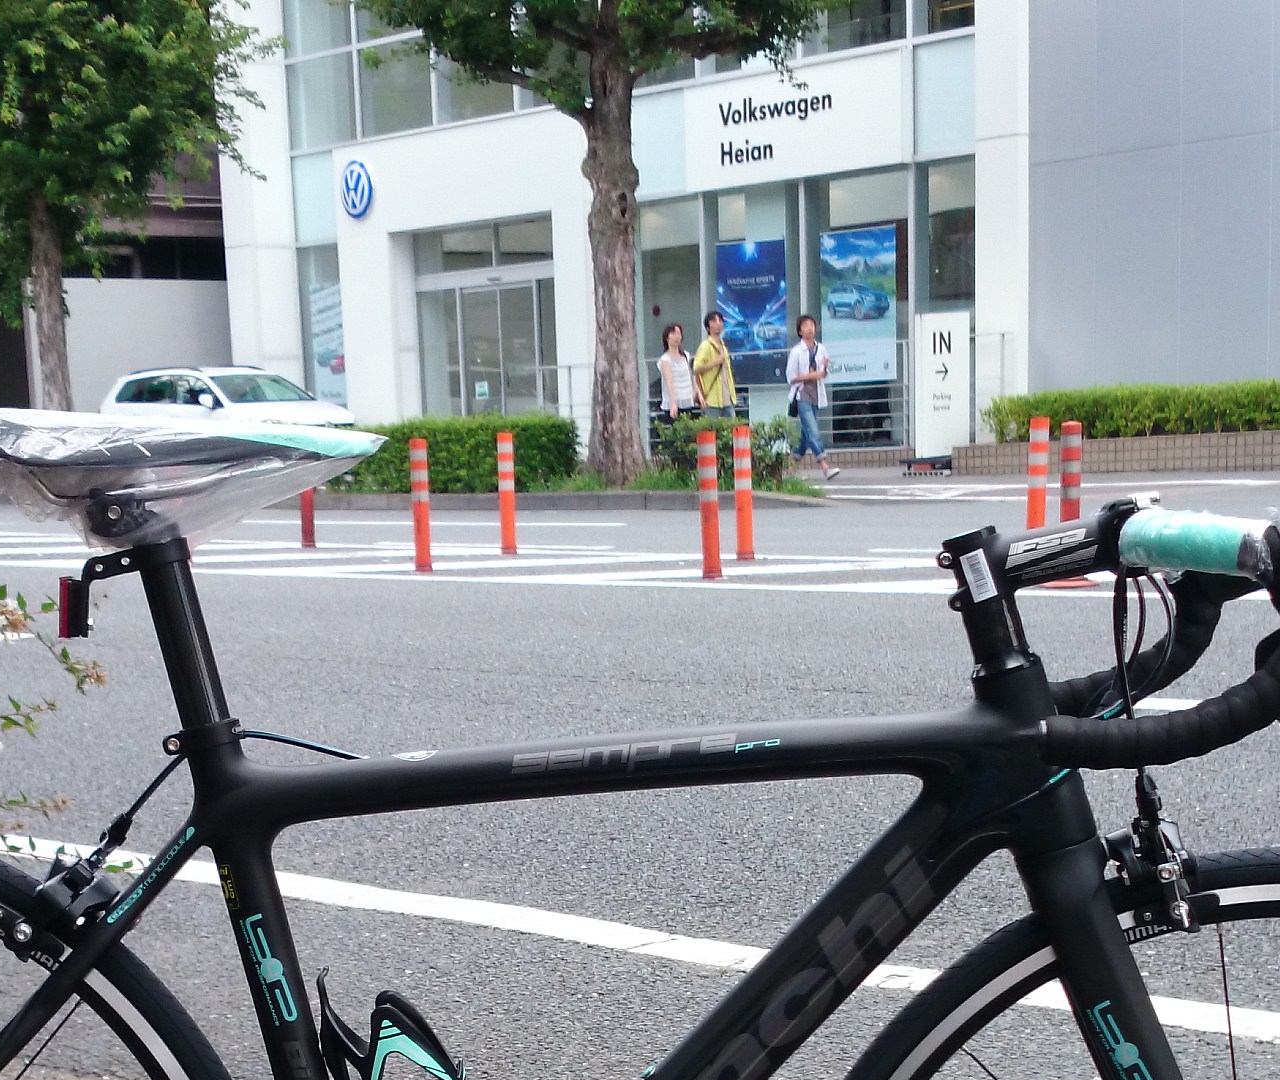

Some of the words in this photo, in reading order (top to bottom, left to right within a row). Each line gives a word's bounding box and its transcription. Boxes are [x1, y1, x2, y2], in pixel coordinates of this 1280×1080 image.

[719, 93, 832, 126] Volkswagen
[720, 138, 774, 166] Heian
[932, 329, 952, 355] IN
[512, 733, 736, 773] sempre
[735, 738, 780, 754] pro
